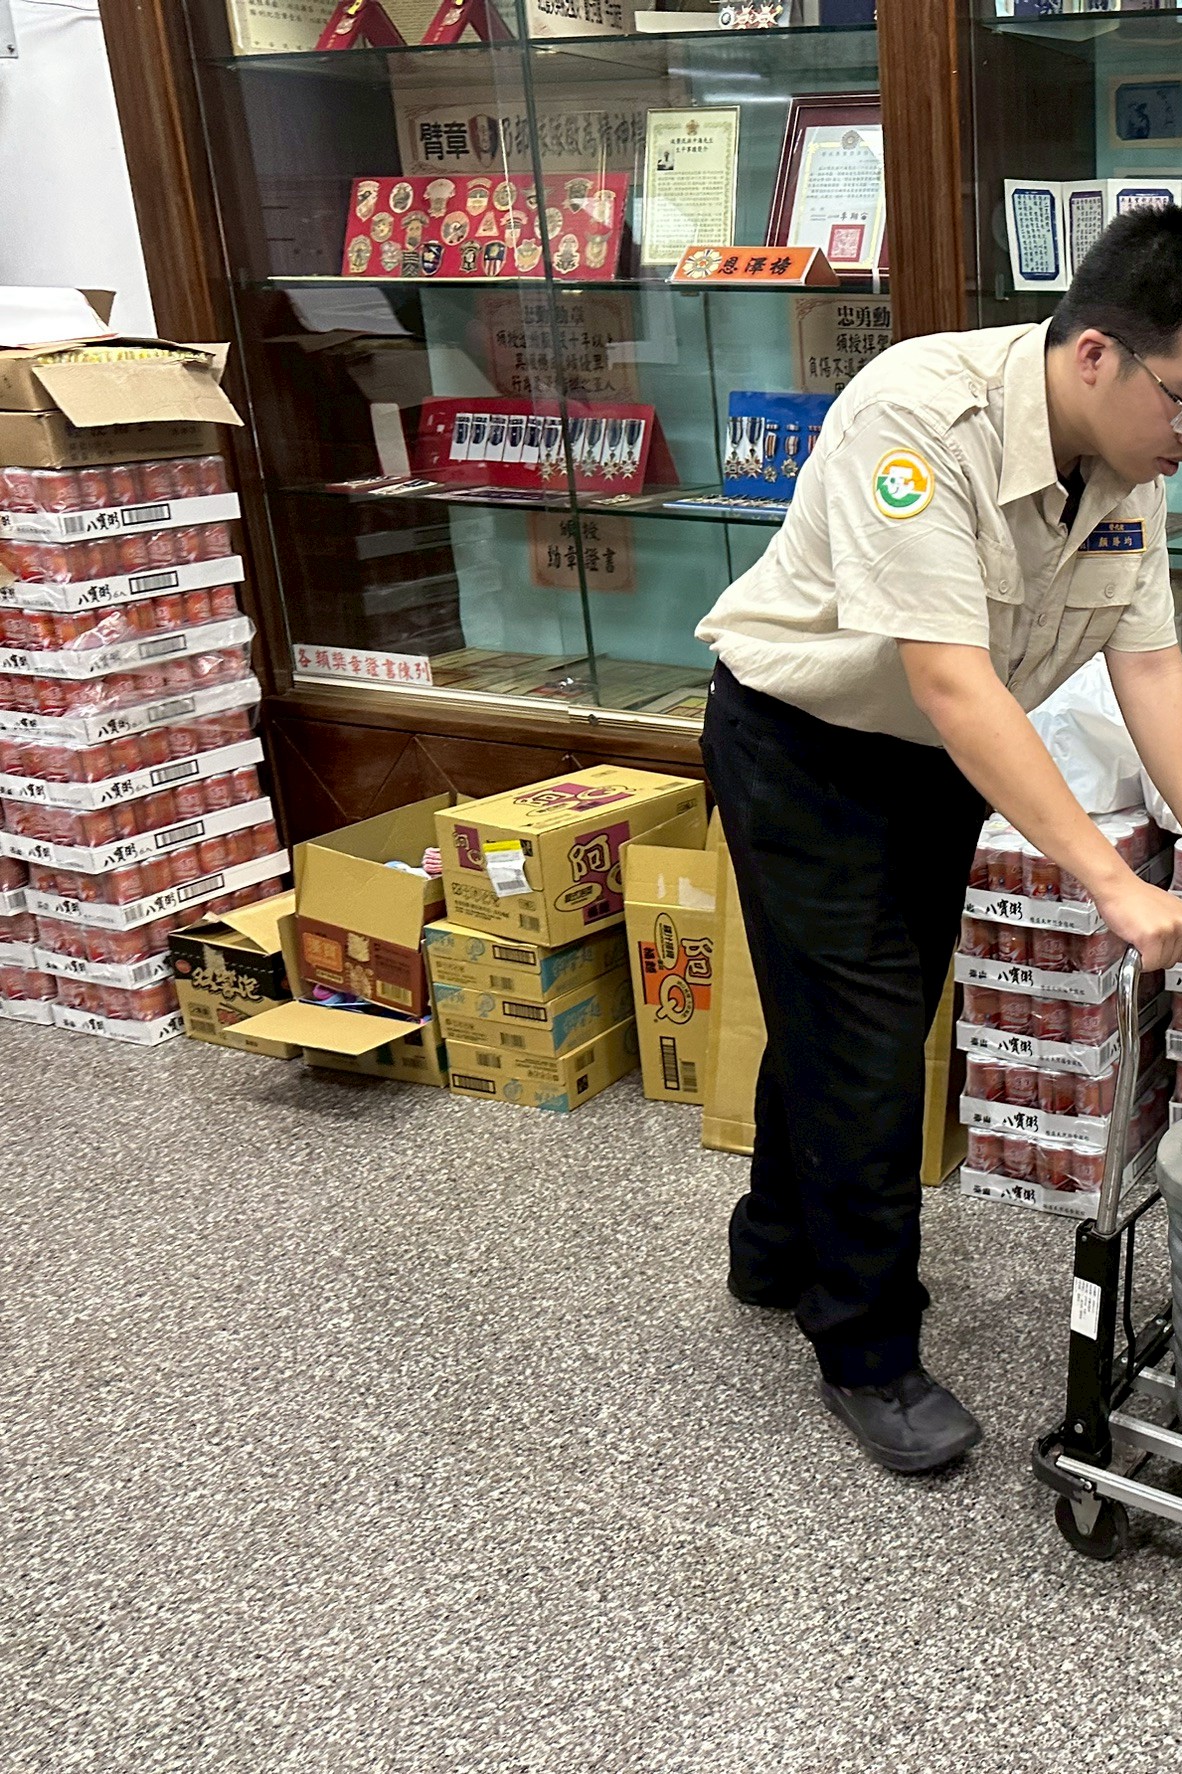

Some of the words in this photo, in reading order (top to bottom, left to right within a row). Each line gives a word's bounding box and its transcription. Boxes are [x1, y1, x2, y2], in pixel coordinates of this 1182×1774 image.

[420, 121, 470, 160] 臂章
[719, 256, 792, 275] 恩澤榜
[86, 511, 121, 533] 八寶粥
[101, 779, 135, 803] 八寶粥
[104, 842, 138, 867] 八寶粥
[986, 899, 1022, 919] 八寶粥
[998, 967, 1034, 987] 八寶粥
[998, 1037, 1033, 1056] 八寶粥
[1003, 1112, 1039, 1133] 八寶粥
[1001, 1185, 1036, 1204] 八寶粥
